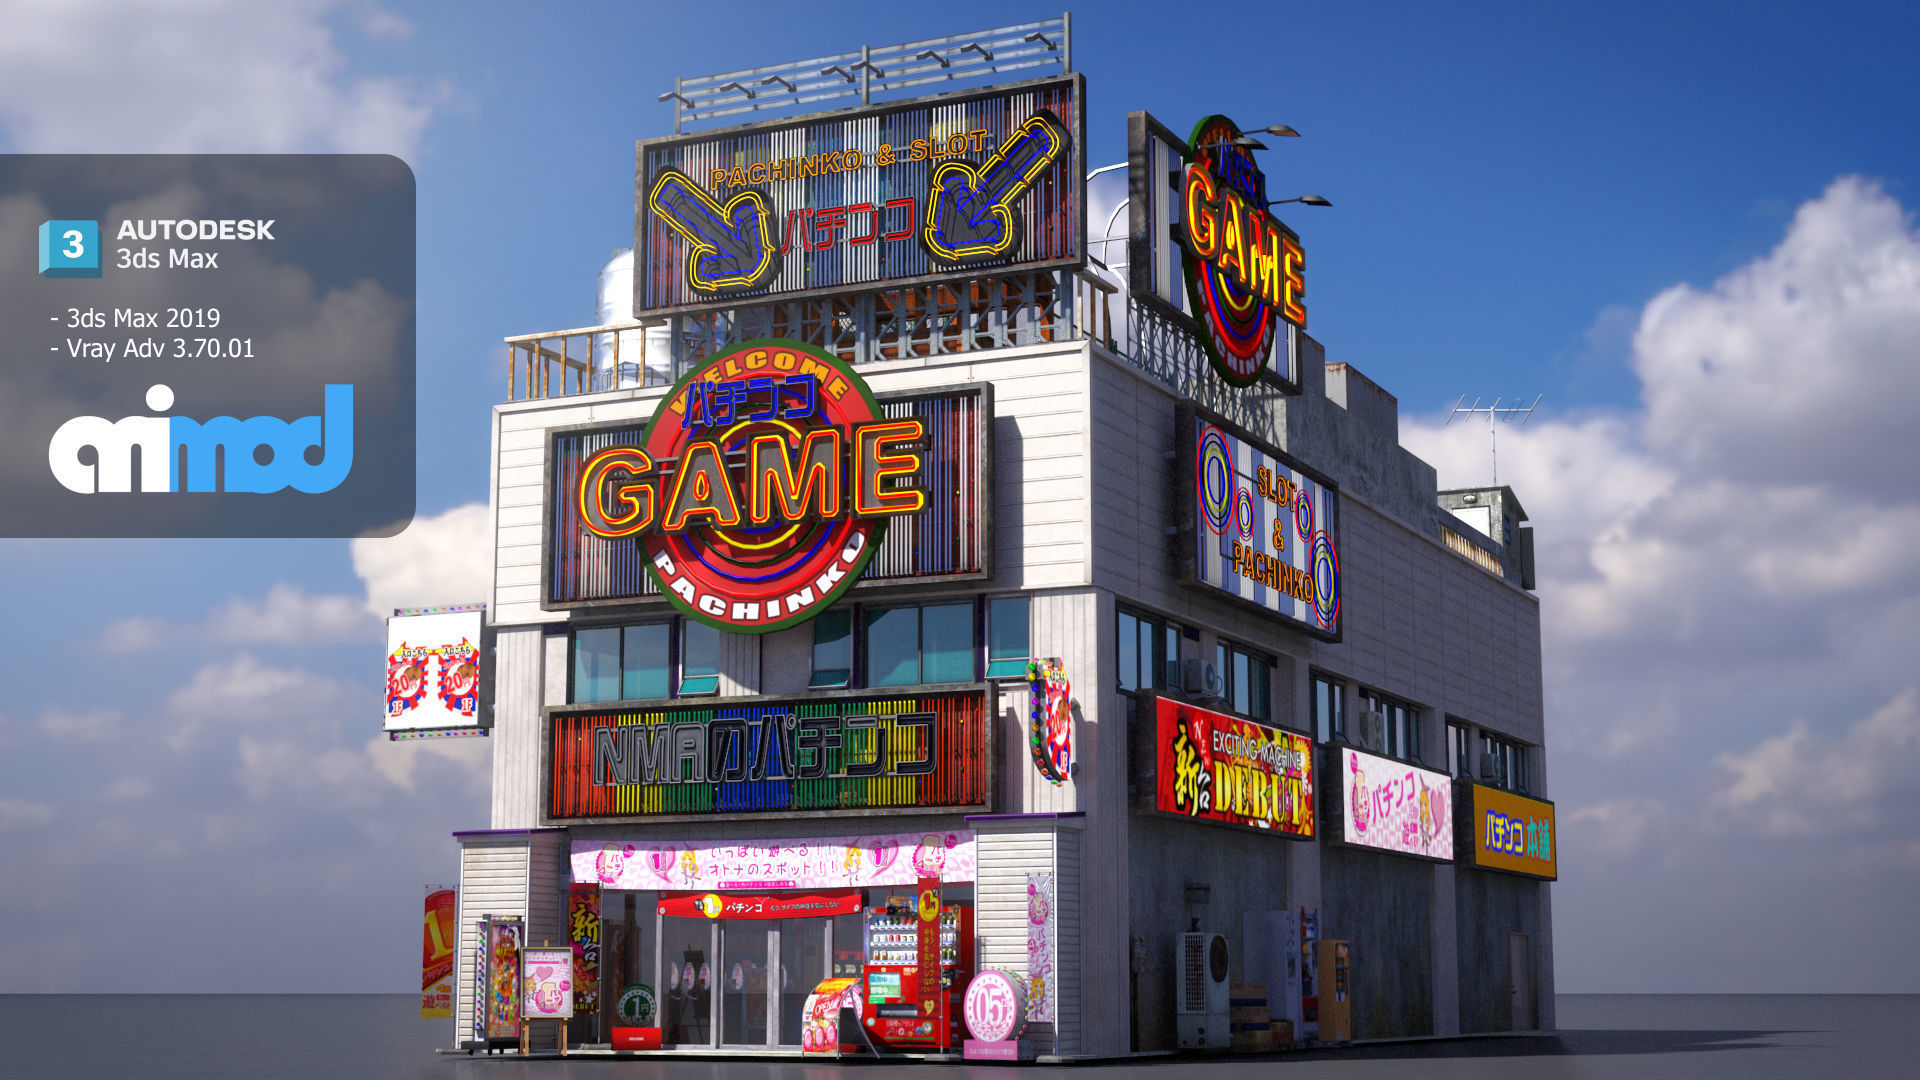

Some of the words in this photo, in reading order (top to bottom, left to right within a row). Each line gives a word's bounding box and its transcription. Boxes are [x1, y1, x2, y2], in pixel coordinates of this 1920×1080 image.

[710, 145, 864, 191] PACHINKO
[875, 143, 897, 166] &
[909, 128, 989, 163] SLOT
[1184, 164, 1306, 328] GAME
[668, 350, 850, 416] WELCOME
[578, 417, 928, 541] GAME
[1257, 464, 1298, 513] SLOT
[1272, 518, 1285, 552] &
[653, 530, 866, 622] PACHINKO
[1232, 539, 1315, 605] PACHINKO
[392, 701, 404, 712] 1F
[462, 699, 473, 712] 1F
[1213, 729, 1258, 760] EXCITING
[1259, 742, 1302, 771] MACHINE
[1214, 760, 1303, 826] DEBUT
[1372, 770, 1416, 825] パチンコ
[1485, 810, 1524, 857] パチンコ
[726, 903, 764, 913] パチンコ
